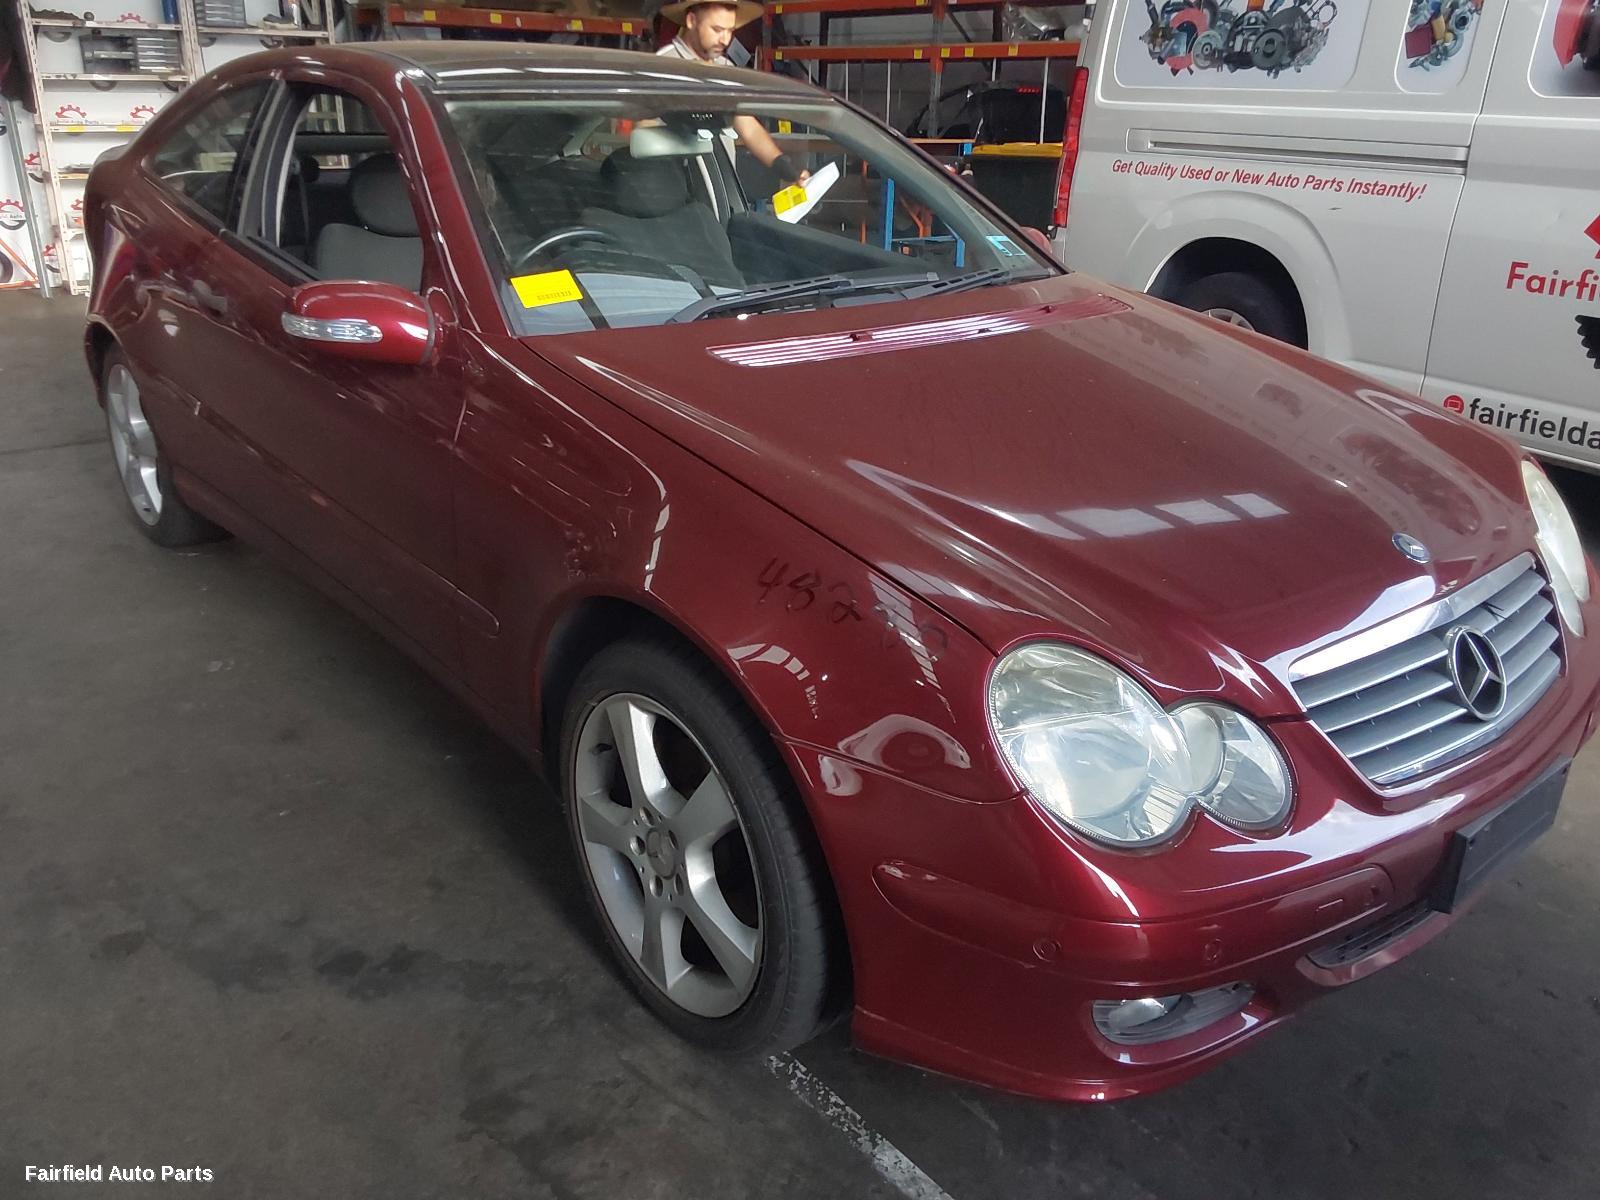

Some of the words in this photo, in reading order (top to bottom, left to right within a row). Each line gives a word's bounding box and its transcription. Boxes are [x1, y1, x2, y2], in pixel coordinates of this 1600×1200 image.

[1112, 159, 1133, 173] Get
[1134, 161, 1178, 181] Quality
[1180, 164, 1214, 181] Used
[1214, 170, 1230, 182] or
[1231, 169, 1264, 185] New
[1265, 171, 1300, 189] Auto
[1302, 174, 1344, 193] Parts
[1346, 177, 1428, 202] Instantly!
[1506, 261, 1600, 302] Fairfi
